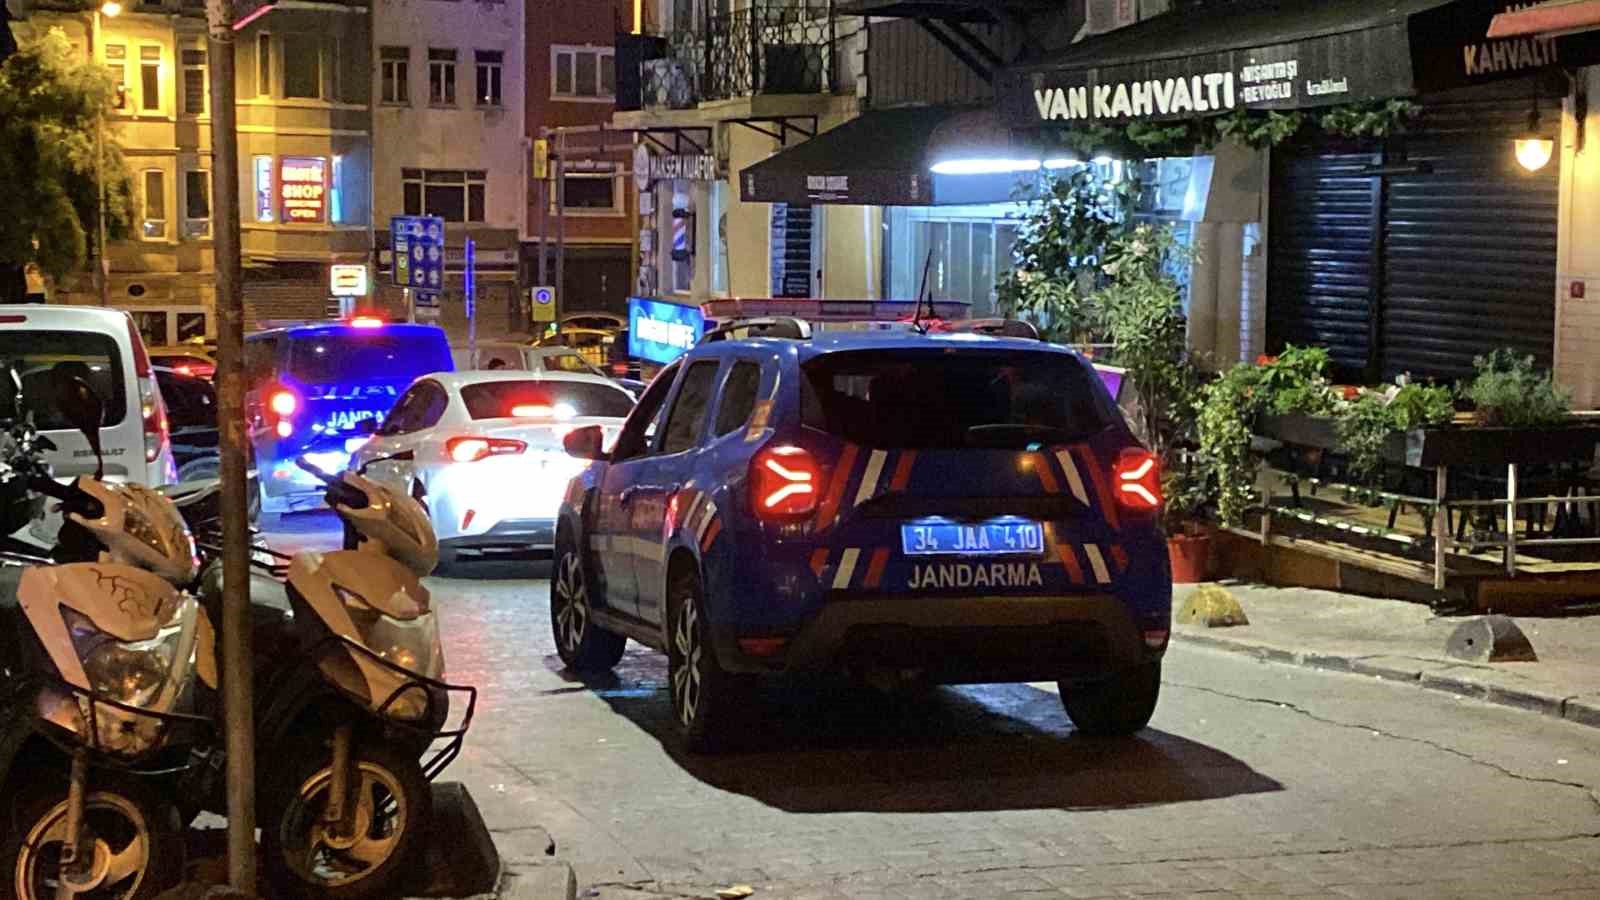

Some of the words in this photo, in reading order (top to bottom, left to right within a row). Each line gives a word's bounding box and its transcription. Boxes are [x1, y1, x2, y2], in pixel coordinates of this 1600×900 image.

[1464, 38, 1558, 75] KAHVALTI
[1034, 86, 1088, 120] VAN
[1093, 72, 1235, 118] KAHVALTI
[282, 184, 323, 198] SHOP
[913, 527, 938, 550] 34
[953, 526, 990, 550] JAA
[1003, 524, 1038, 550] 410
[908, 562, 1043, 589] JANDARMA
